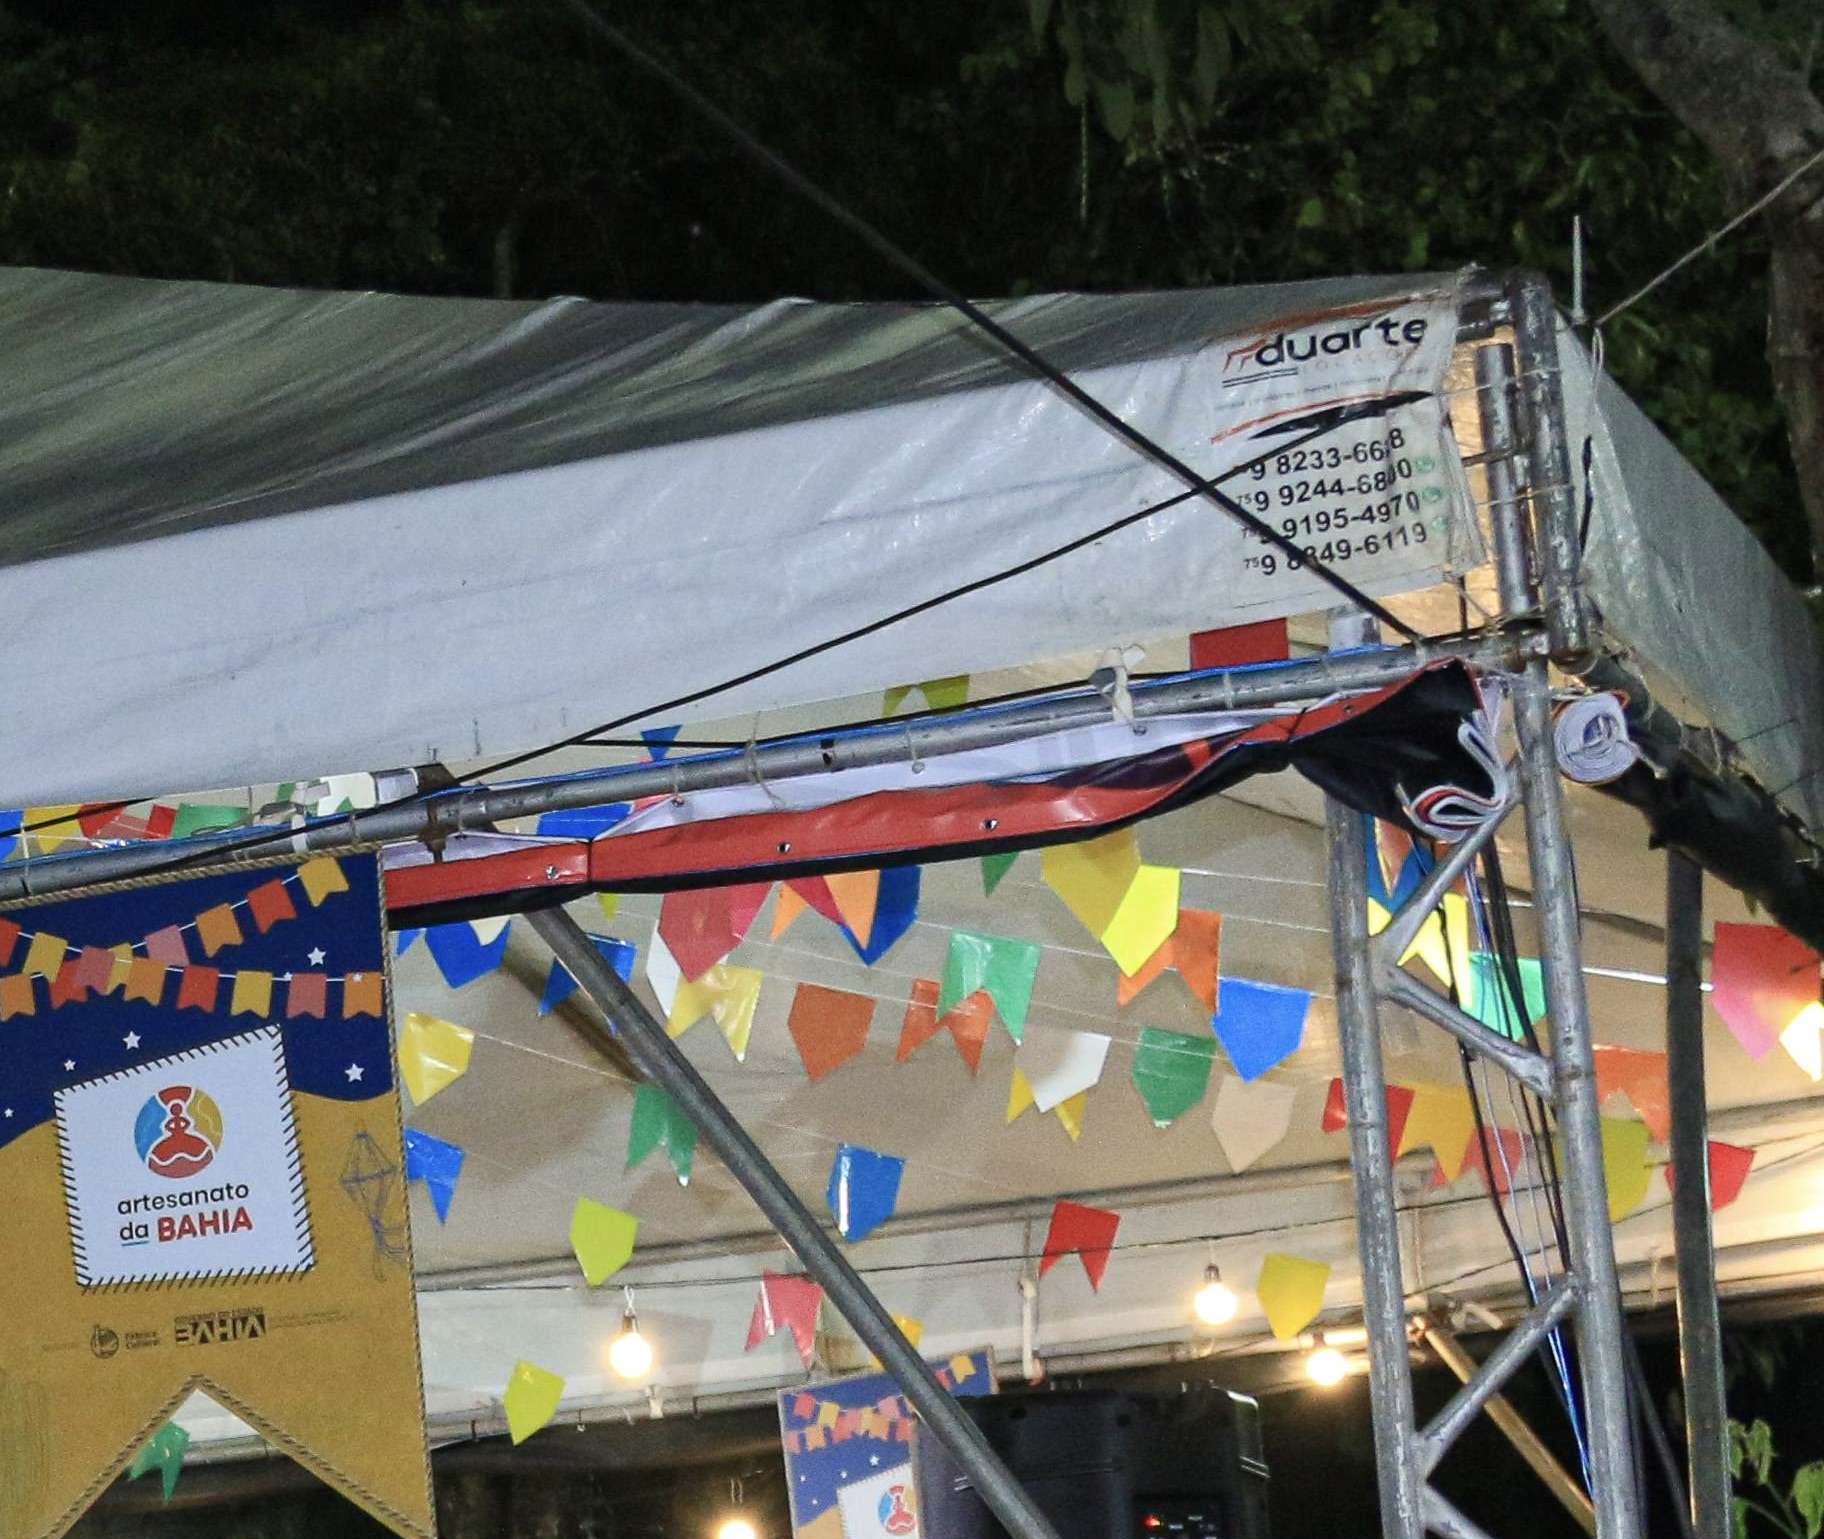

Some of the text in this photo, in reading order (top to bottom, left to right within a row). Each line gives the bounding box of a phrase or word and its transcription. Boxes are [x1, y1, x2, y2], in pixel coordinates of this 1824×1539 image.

[1255, 318, 1427, 366] duarte
[118, 1183, 249, 1215] artesanato
[120, 1206, 253, 1243] da BAHIA
